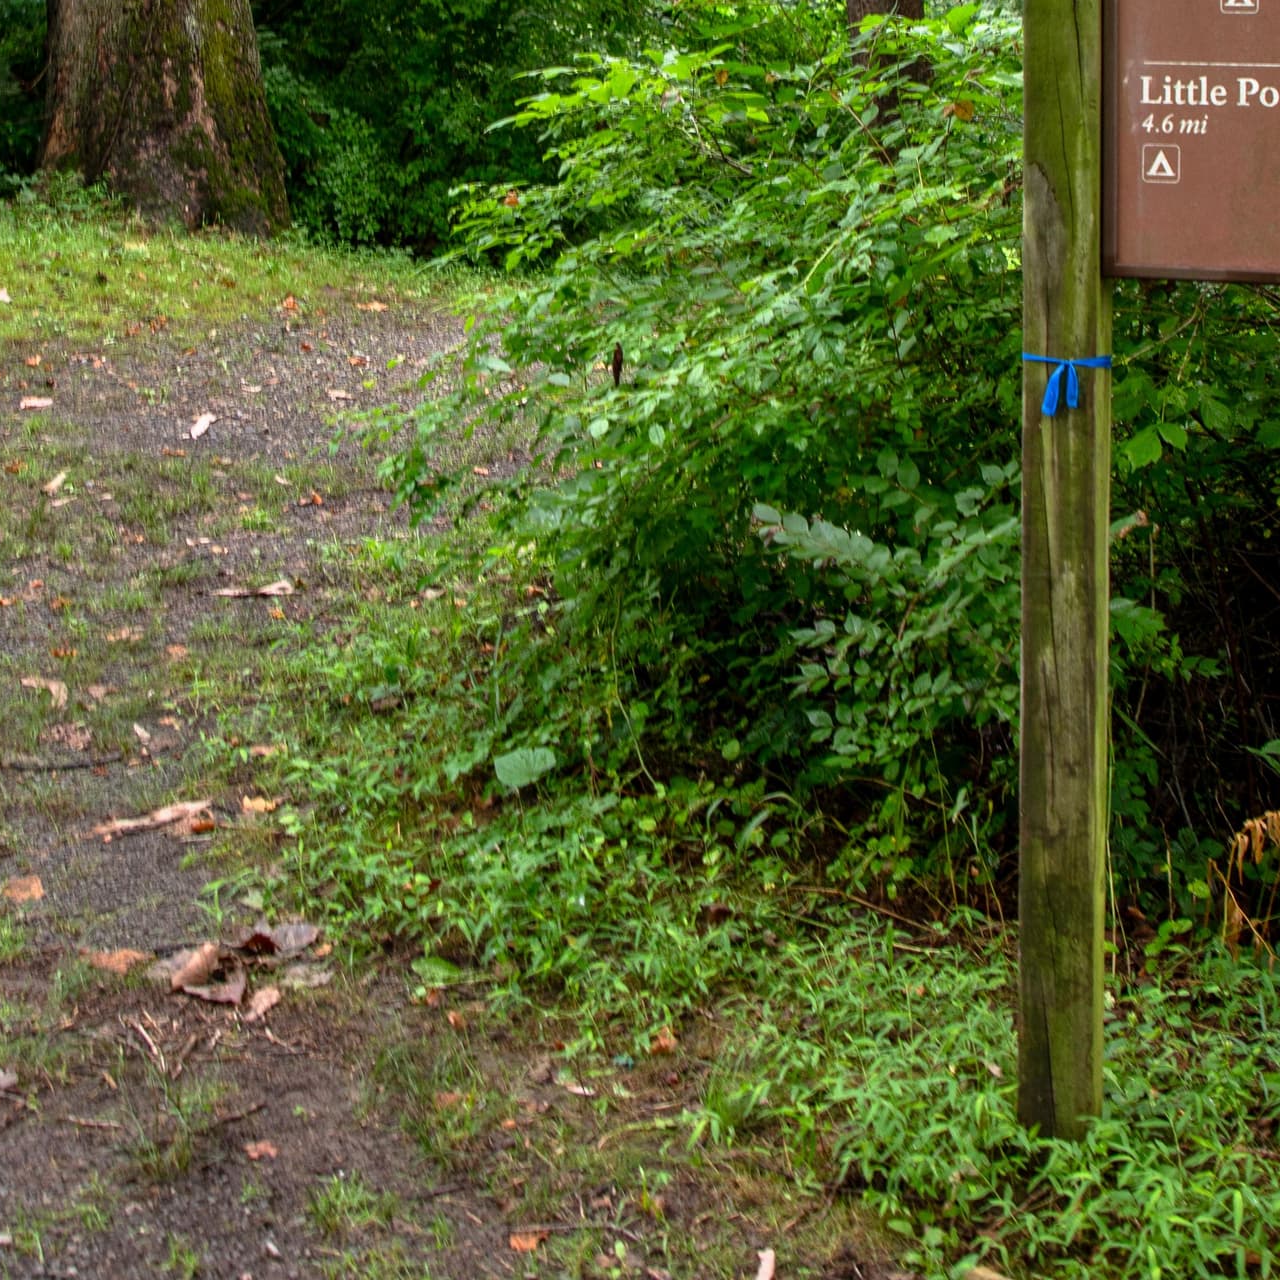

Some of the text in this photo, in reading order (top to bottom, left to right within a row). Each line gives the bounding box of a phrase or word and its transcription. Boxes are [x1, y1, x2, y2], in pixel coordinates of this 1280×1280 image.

[1140, 75, 1228, 107] Little
[1140, 113, 1209, 135] 4.6 mi
